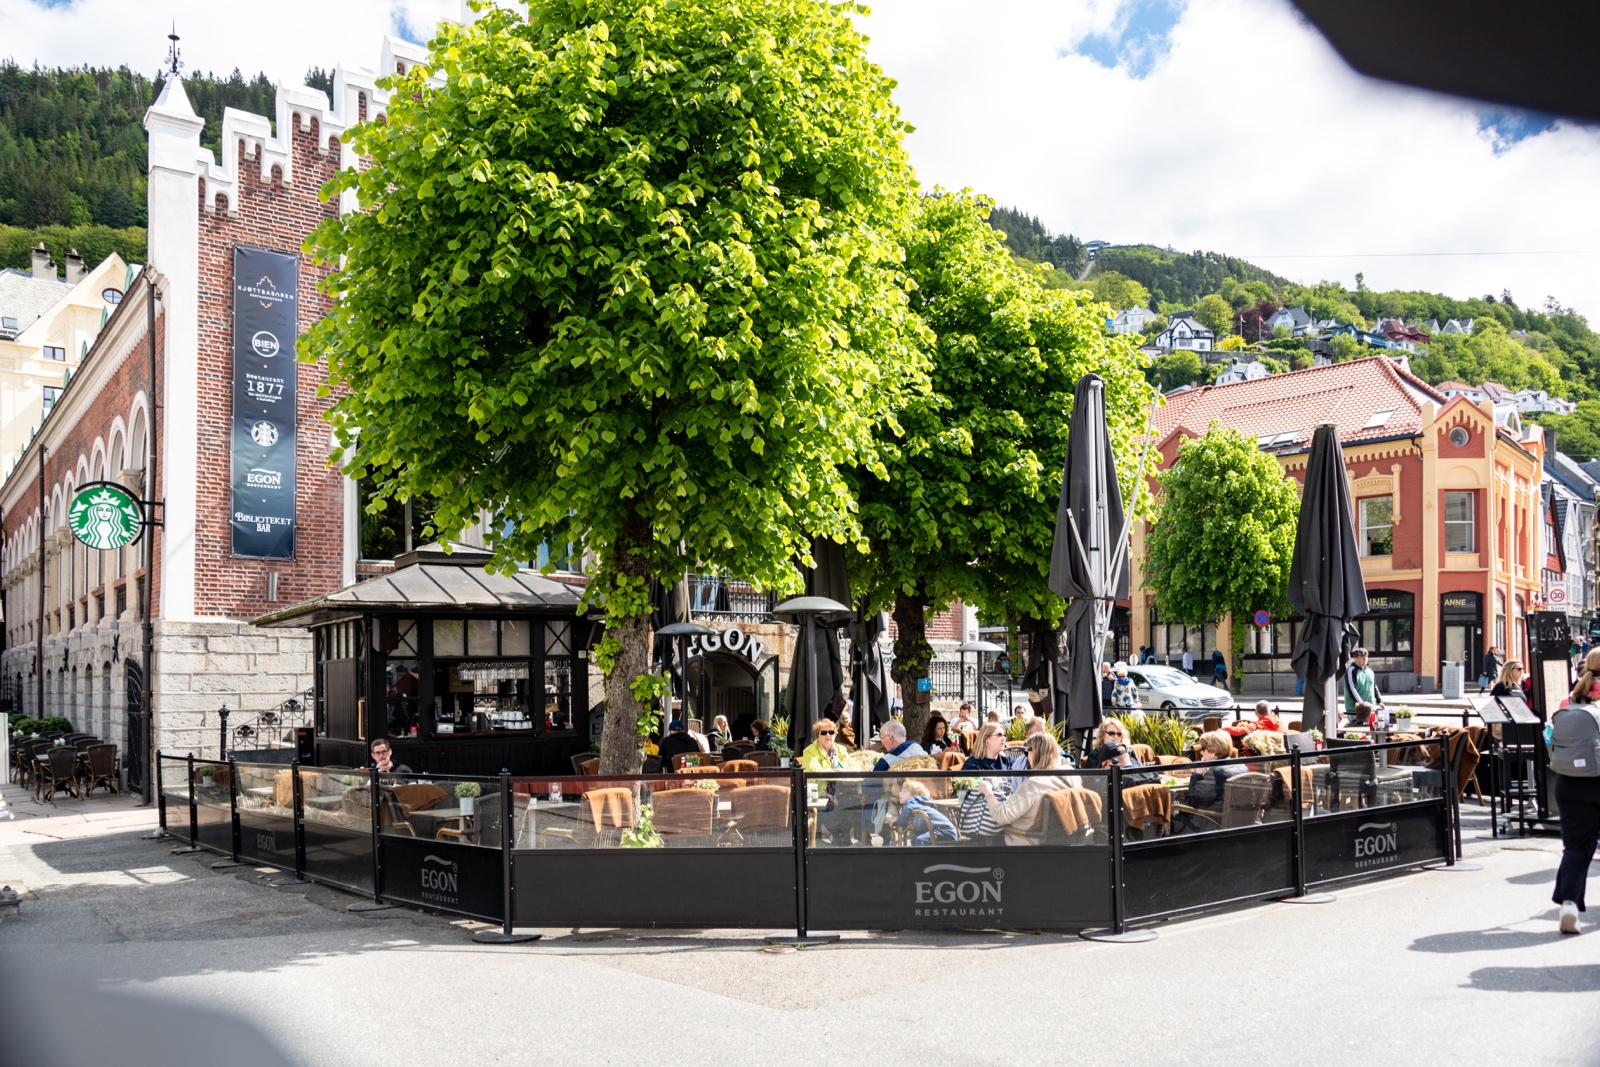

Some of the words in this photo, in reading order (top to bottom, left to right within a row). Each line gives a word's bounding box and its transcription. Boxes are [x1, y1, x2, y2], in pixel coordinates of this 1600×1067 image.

[254, 339, 277, 350] BIEN
[246, 373, 285, 384] Restaurant
[247, 380, 284, 395] 1877
[247, 473, 281, 485] EGON
[256, 523, 271, 533] BAR
[1444, 598, 1467, 606] ANNE
[256, 834, 276, 851] EGON
[1354, 833, 1397, 858] EGON
[1355, 855, 1398, 868] RESTAURANT
[421, 868, 458, 893] EGON
[915, 881, 1003, 903] EGON
[915, 908, 1004, 917] RESTAURANT
